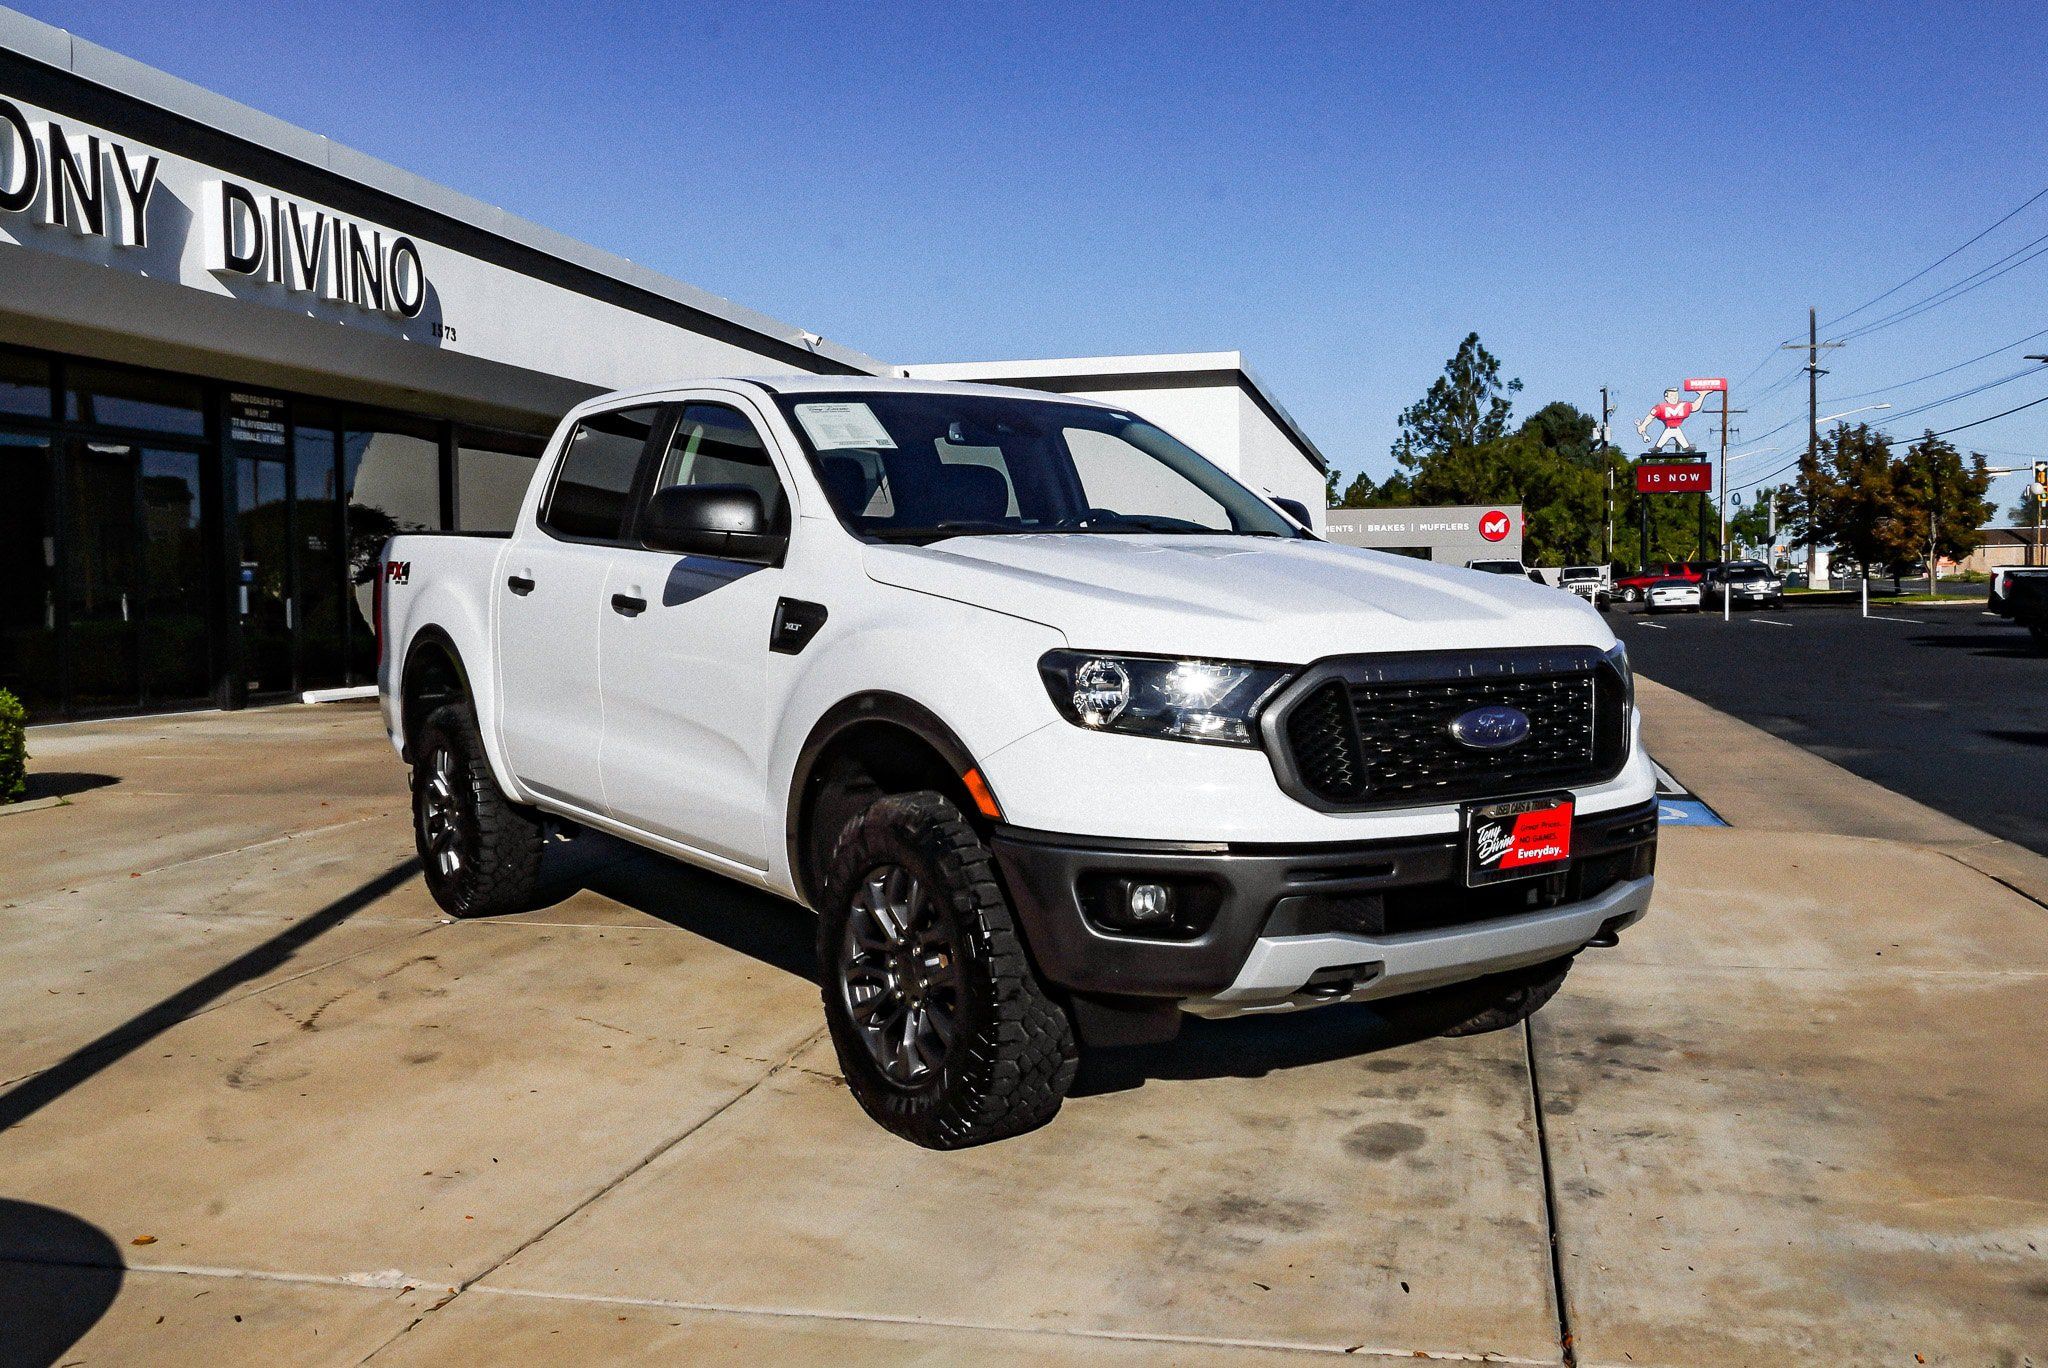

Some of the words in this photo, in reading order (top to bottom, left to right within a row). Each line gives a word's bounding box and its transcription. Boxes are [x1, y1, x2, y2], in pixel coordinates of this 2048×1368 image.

[220, 180, 427, 319] DIVINO
[431, 322, 457, 342] 1573
[1647, 474, 1661, 483] IS
[1668, 473, 1700, 482] NOW
[1367, 524, 1406, 532] BRAKES
[1419, 522, 1470, 531] MUFFLERS
[385, 561, 411, 584] FX4
[785, 622, 802, 632] XLT
[1477, 821, 1502, 845] Tony
[1476, 834, 1516, 860] Divino
[1517, 845, 1562, 858] Everyday.
